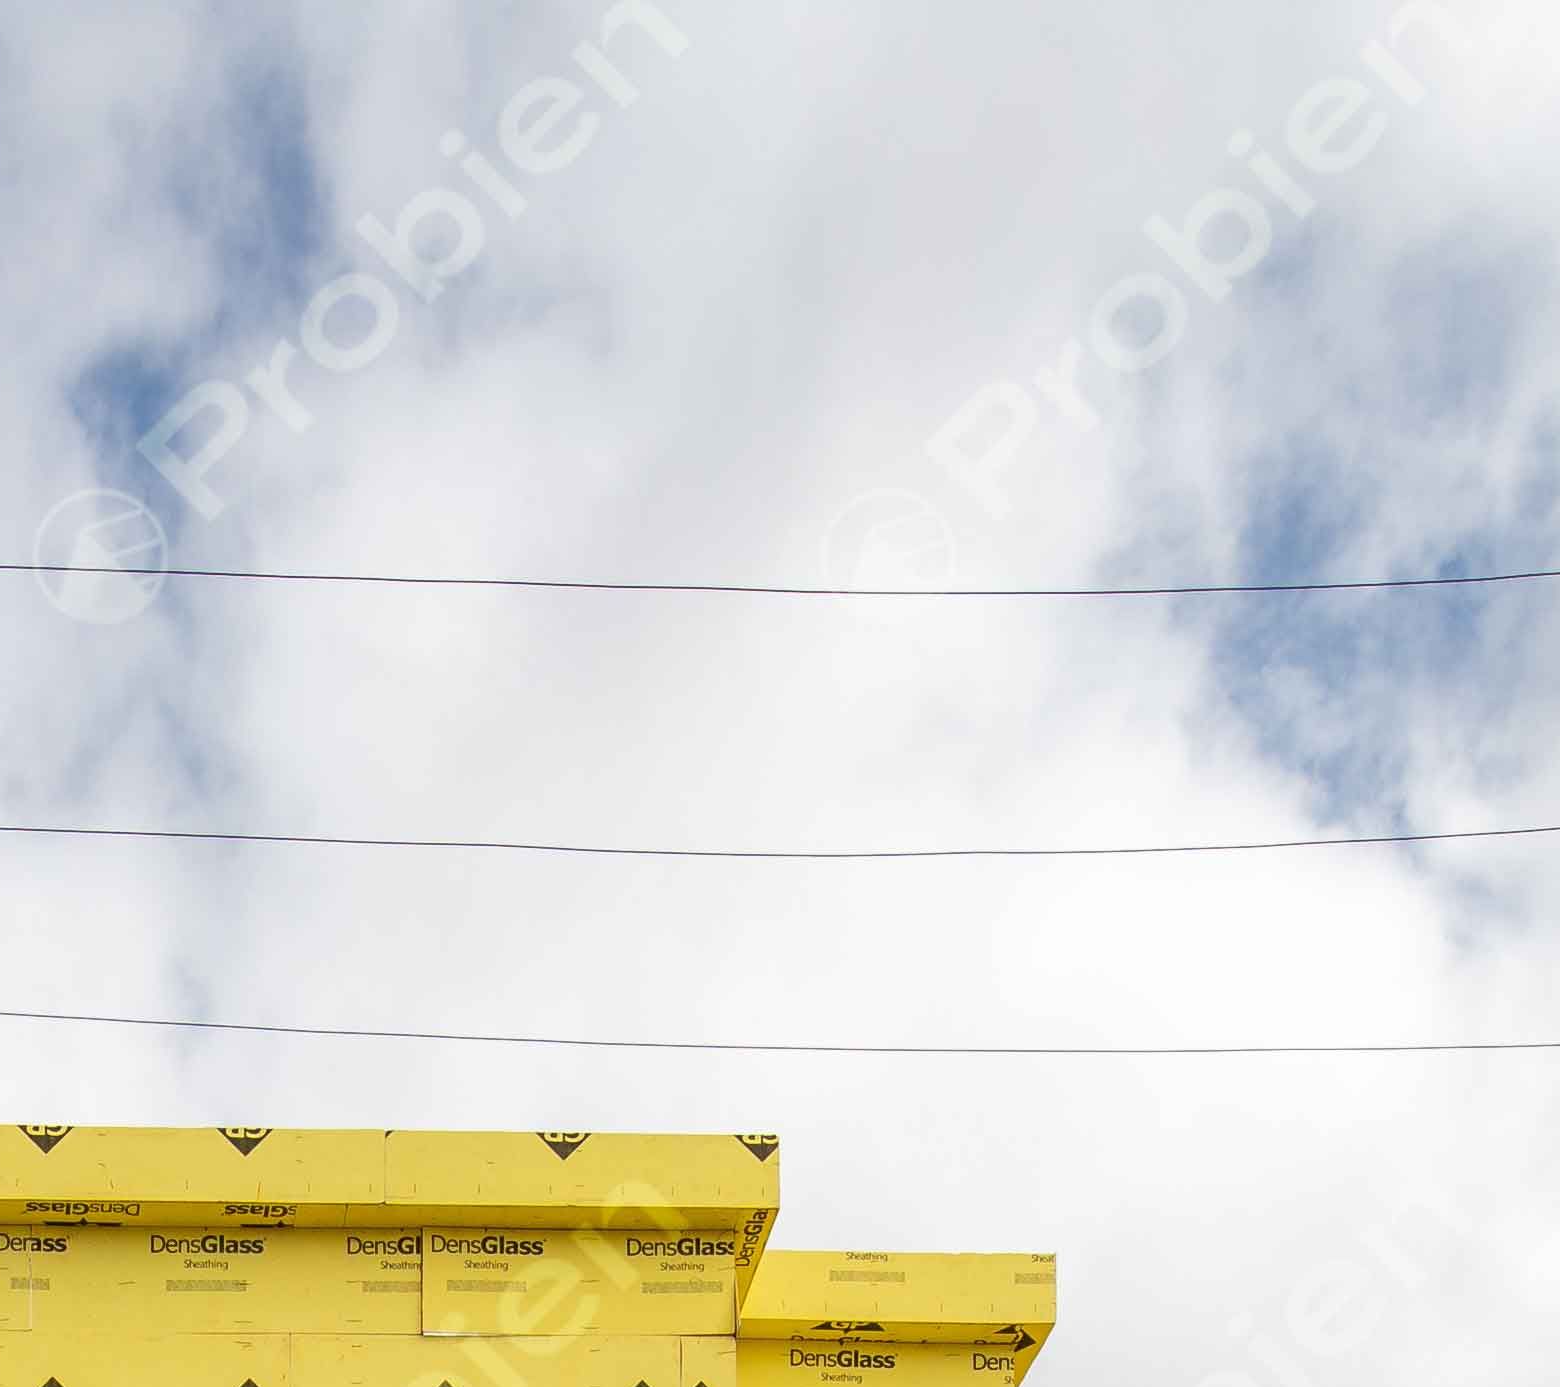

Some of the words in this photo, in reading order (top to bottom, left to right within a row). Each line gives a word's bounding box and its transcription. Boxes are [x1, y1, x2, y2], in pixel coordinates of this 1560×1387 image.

[24, 1201, 140, 1217] DensGlass
[223, 1203, 297, 1217] sGlass
[150, 1233, 264, 1255] DensGlass
[431, 1234, 544, 1256] DensGlass
[735, 1208, 768, 1267] DensGla
[346, 1235, 421, 1256] DensGl
[183, 1258, 229, 1271] Sheathing
[846, 1252, 888, 1262] Sheathing
[463, 1258, 508, 1272] Sheathing
[659, 1260, 705, 1273] Sheathing
[790, 1349, 896, 1369] DensGlass
[821, 1372, 863, 1384] Sheathing
